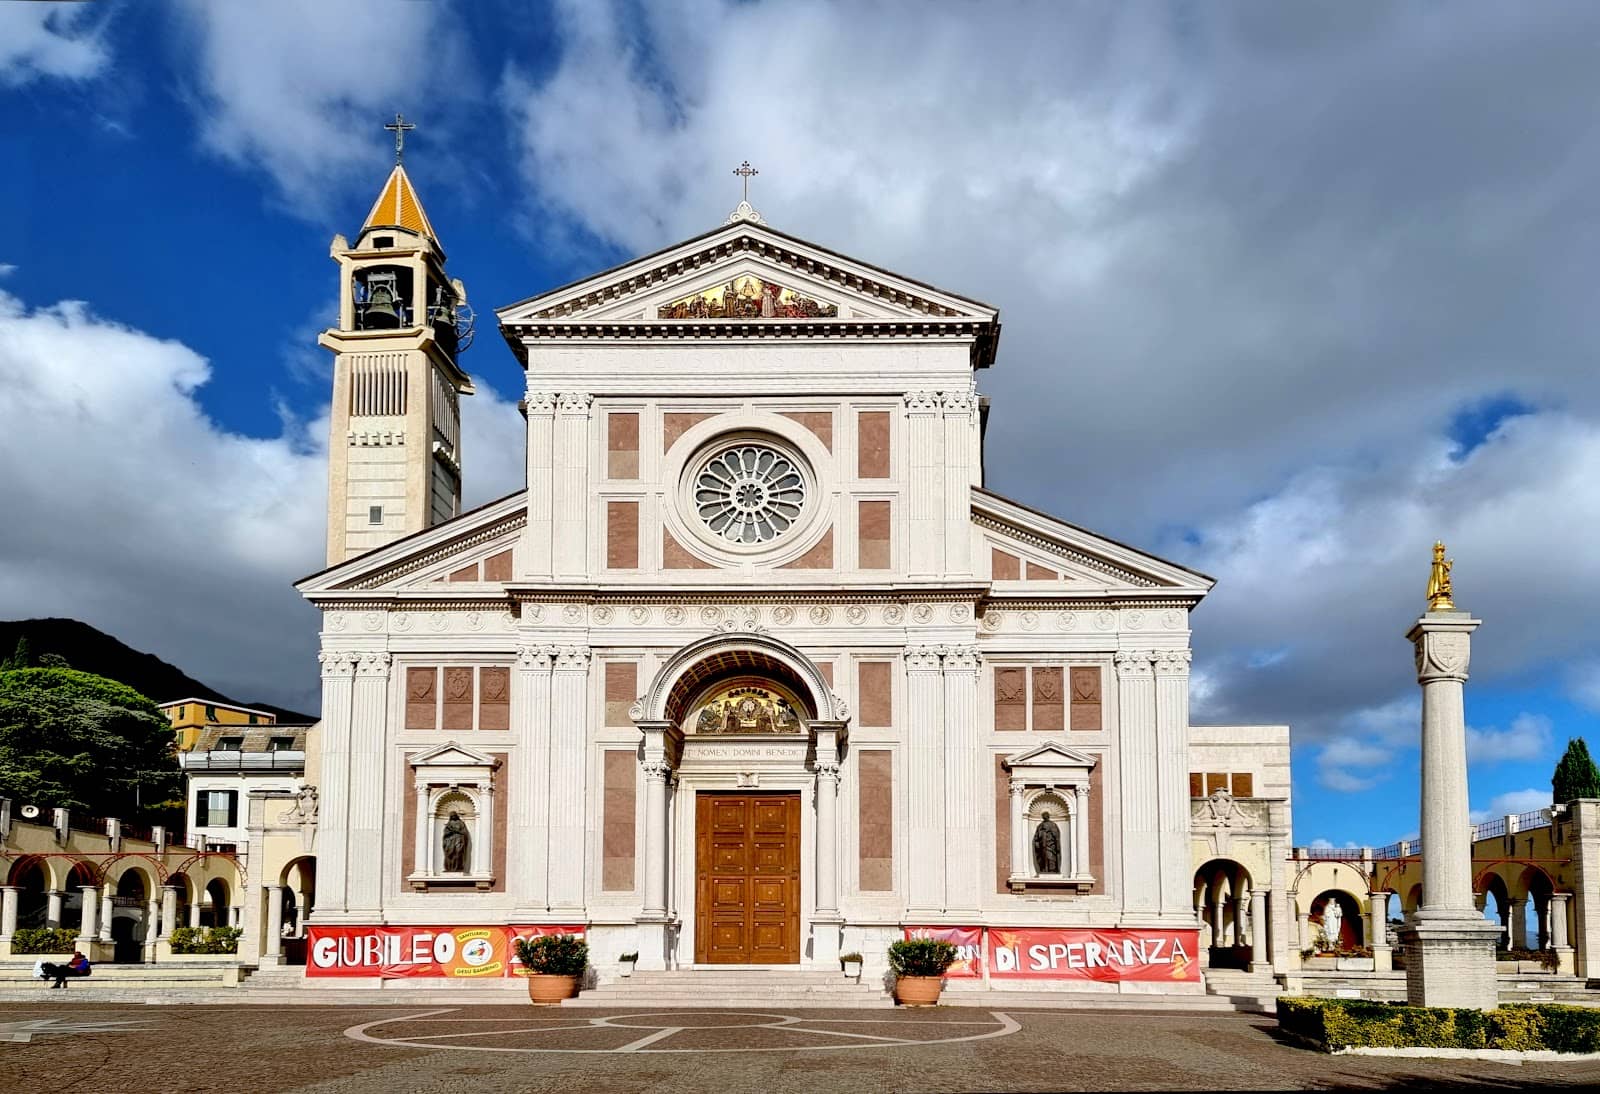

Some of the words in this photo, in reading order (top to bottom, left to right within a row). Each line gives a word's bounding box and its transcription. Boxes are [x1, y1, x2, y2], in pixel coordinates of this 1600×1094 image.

[697, 748, 727, 757] NOMEN
[733, 748, 761, 757] DOMINI
[766, 748, 805, 757] BENEDICT
[458, 931, 489, 940] SANTUARIO
[313, 932, 456, 968] GIUBILEO
[995, 946, 1020, 971] DI
[1028, 937, 1189, 971] SPERANZA
